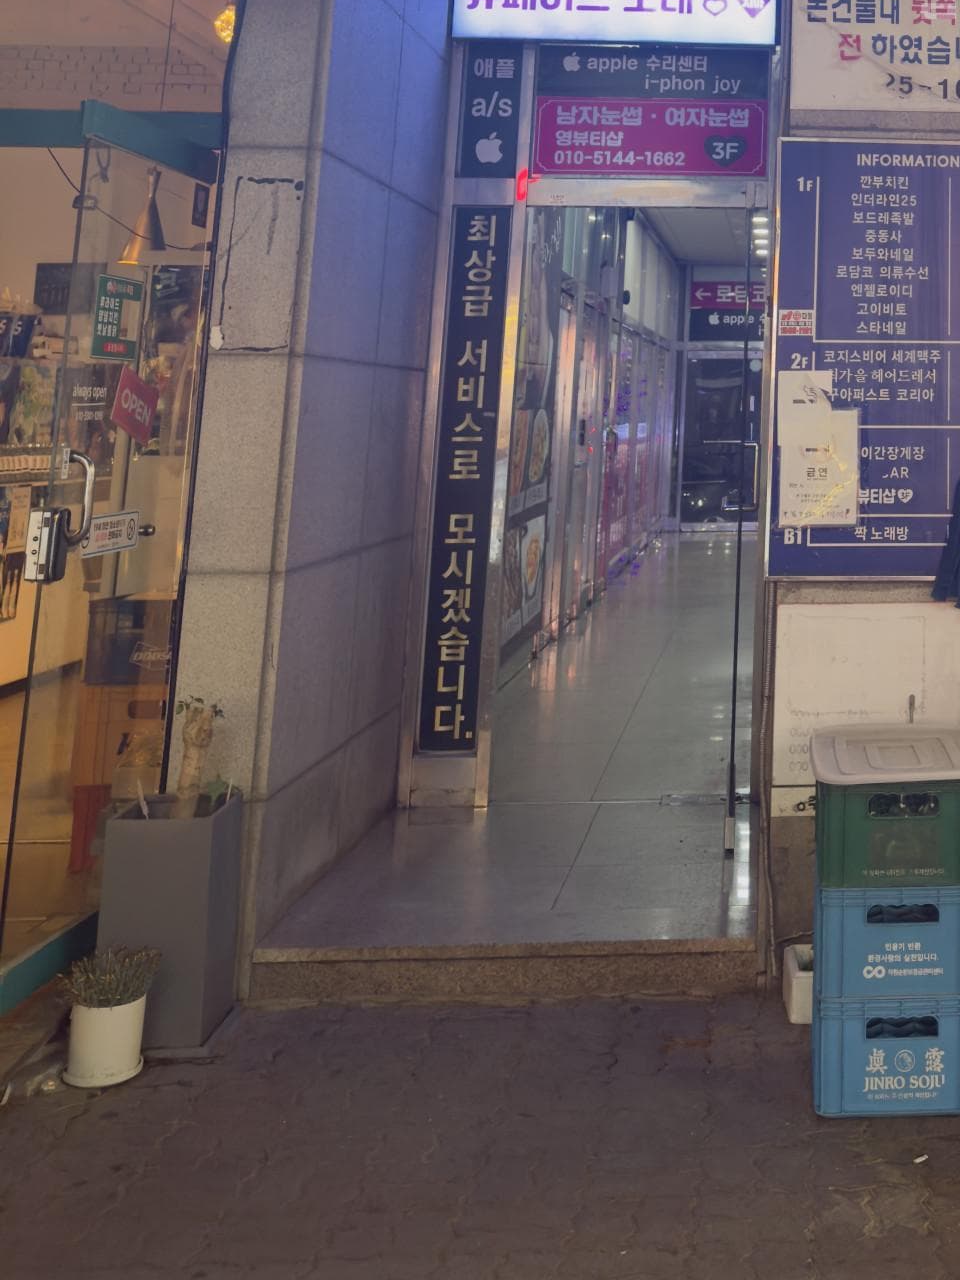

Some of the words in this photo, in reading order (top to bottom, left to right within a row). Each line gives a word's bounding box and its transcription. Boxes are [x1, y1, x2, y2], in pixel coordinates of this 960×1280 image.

[474, 58, 516, 80] 애플
[587, 55, 639, 73] apple
[646, 55, 708, 72] 수리센터
[645, 74, 705, 93] i-phon
[712, 75, 742, 95] joy
[471, 91, 513, 118] a/s
[556, 105, 643, 126] 남자눈썹
[665, 106, 750, 128] 여자눈썹
[555, 130, 625, 147] 영뷰티샵
[554, 150, 686, 166] 010-5144-1662
[711, 141, 740, 160] 3F
[856, 154, 960, 169] INFORMATION
[796, 176, 814, 192] 1F
[860, 175, 909, 190] 깐부치킨
[851, 192, 917, 207] 인더라인25
[852, 211, 914, 226] 보드레족발
[865, 229, 902, 244] 중동사
[462, 213, 498, 318] 최상급
[836, 265, 873, 279] 로담코
[880, 265, 929, 280] 의류수선
[851, 283, 913, 298] 엔젤로이디
[723, 314, 754, 326] appe
[856, 321, 906, 336] 스타네일
[791, 353, 808, 369] 2F
[824, 350, 887, 364] 코지스비어
[891, 349, 941, 364] 세계맥주
[871, 368, 936, 384] 헤어드레서
[896, 388, 935, 402] 코리아
[121, 388, 151, 426] OPEN
[447, 338, 488, 481] 서비스로
[882, 466, 909, 479] AR
[784, 528, 802, 544] B1
[871, 525, 909, 541] 노래방
[433, 512, 476, 741] 모시겠습니다.
[863, 1075, 906, 1092] JINRO
[909, 1074, 945, 1090] SOJU
